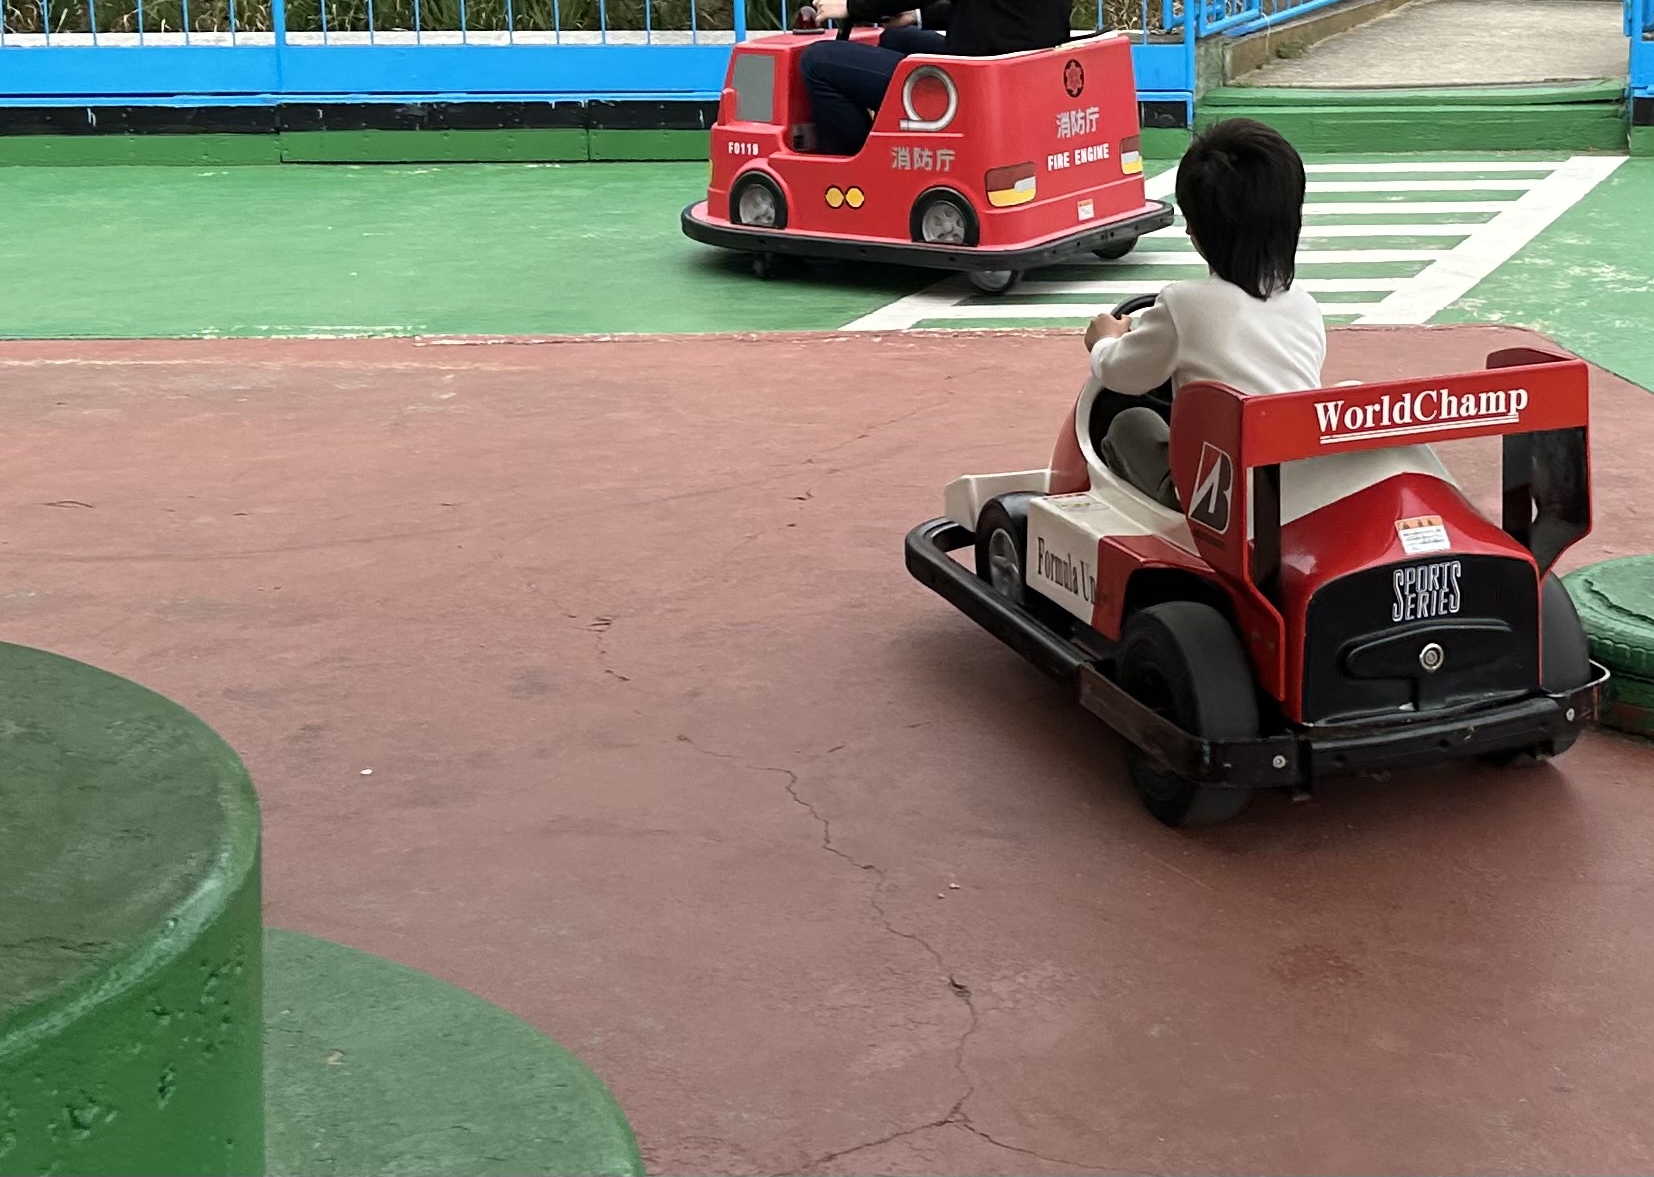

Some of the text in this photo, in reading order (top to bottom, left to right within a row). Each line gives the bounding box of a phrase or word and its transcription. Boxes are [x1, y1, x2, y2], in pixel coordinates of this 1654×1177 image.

[1056, 106, 1100, 139] 消防庁
[891, 146, 956, 172] 消防庁
[1047, 143, 1110, 172] FIRE ENGINE
[1314, 388, 1529, 433] WorldChamp
[1037, 536, 1079, 597] Formula
